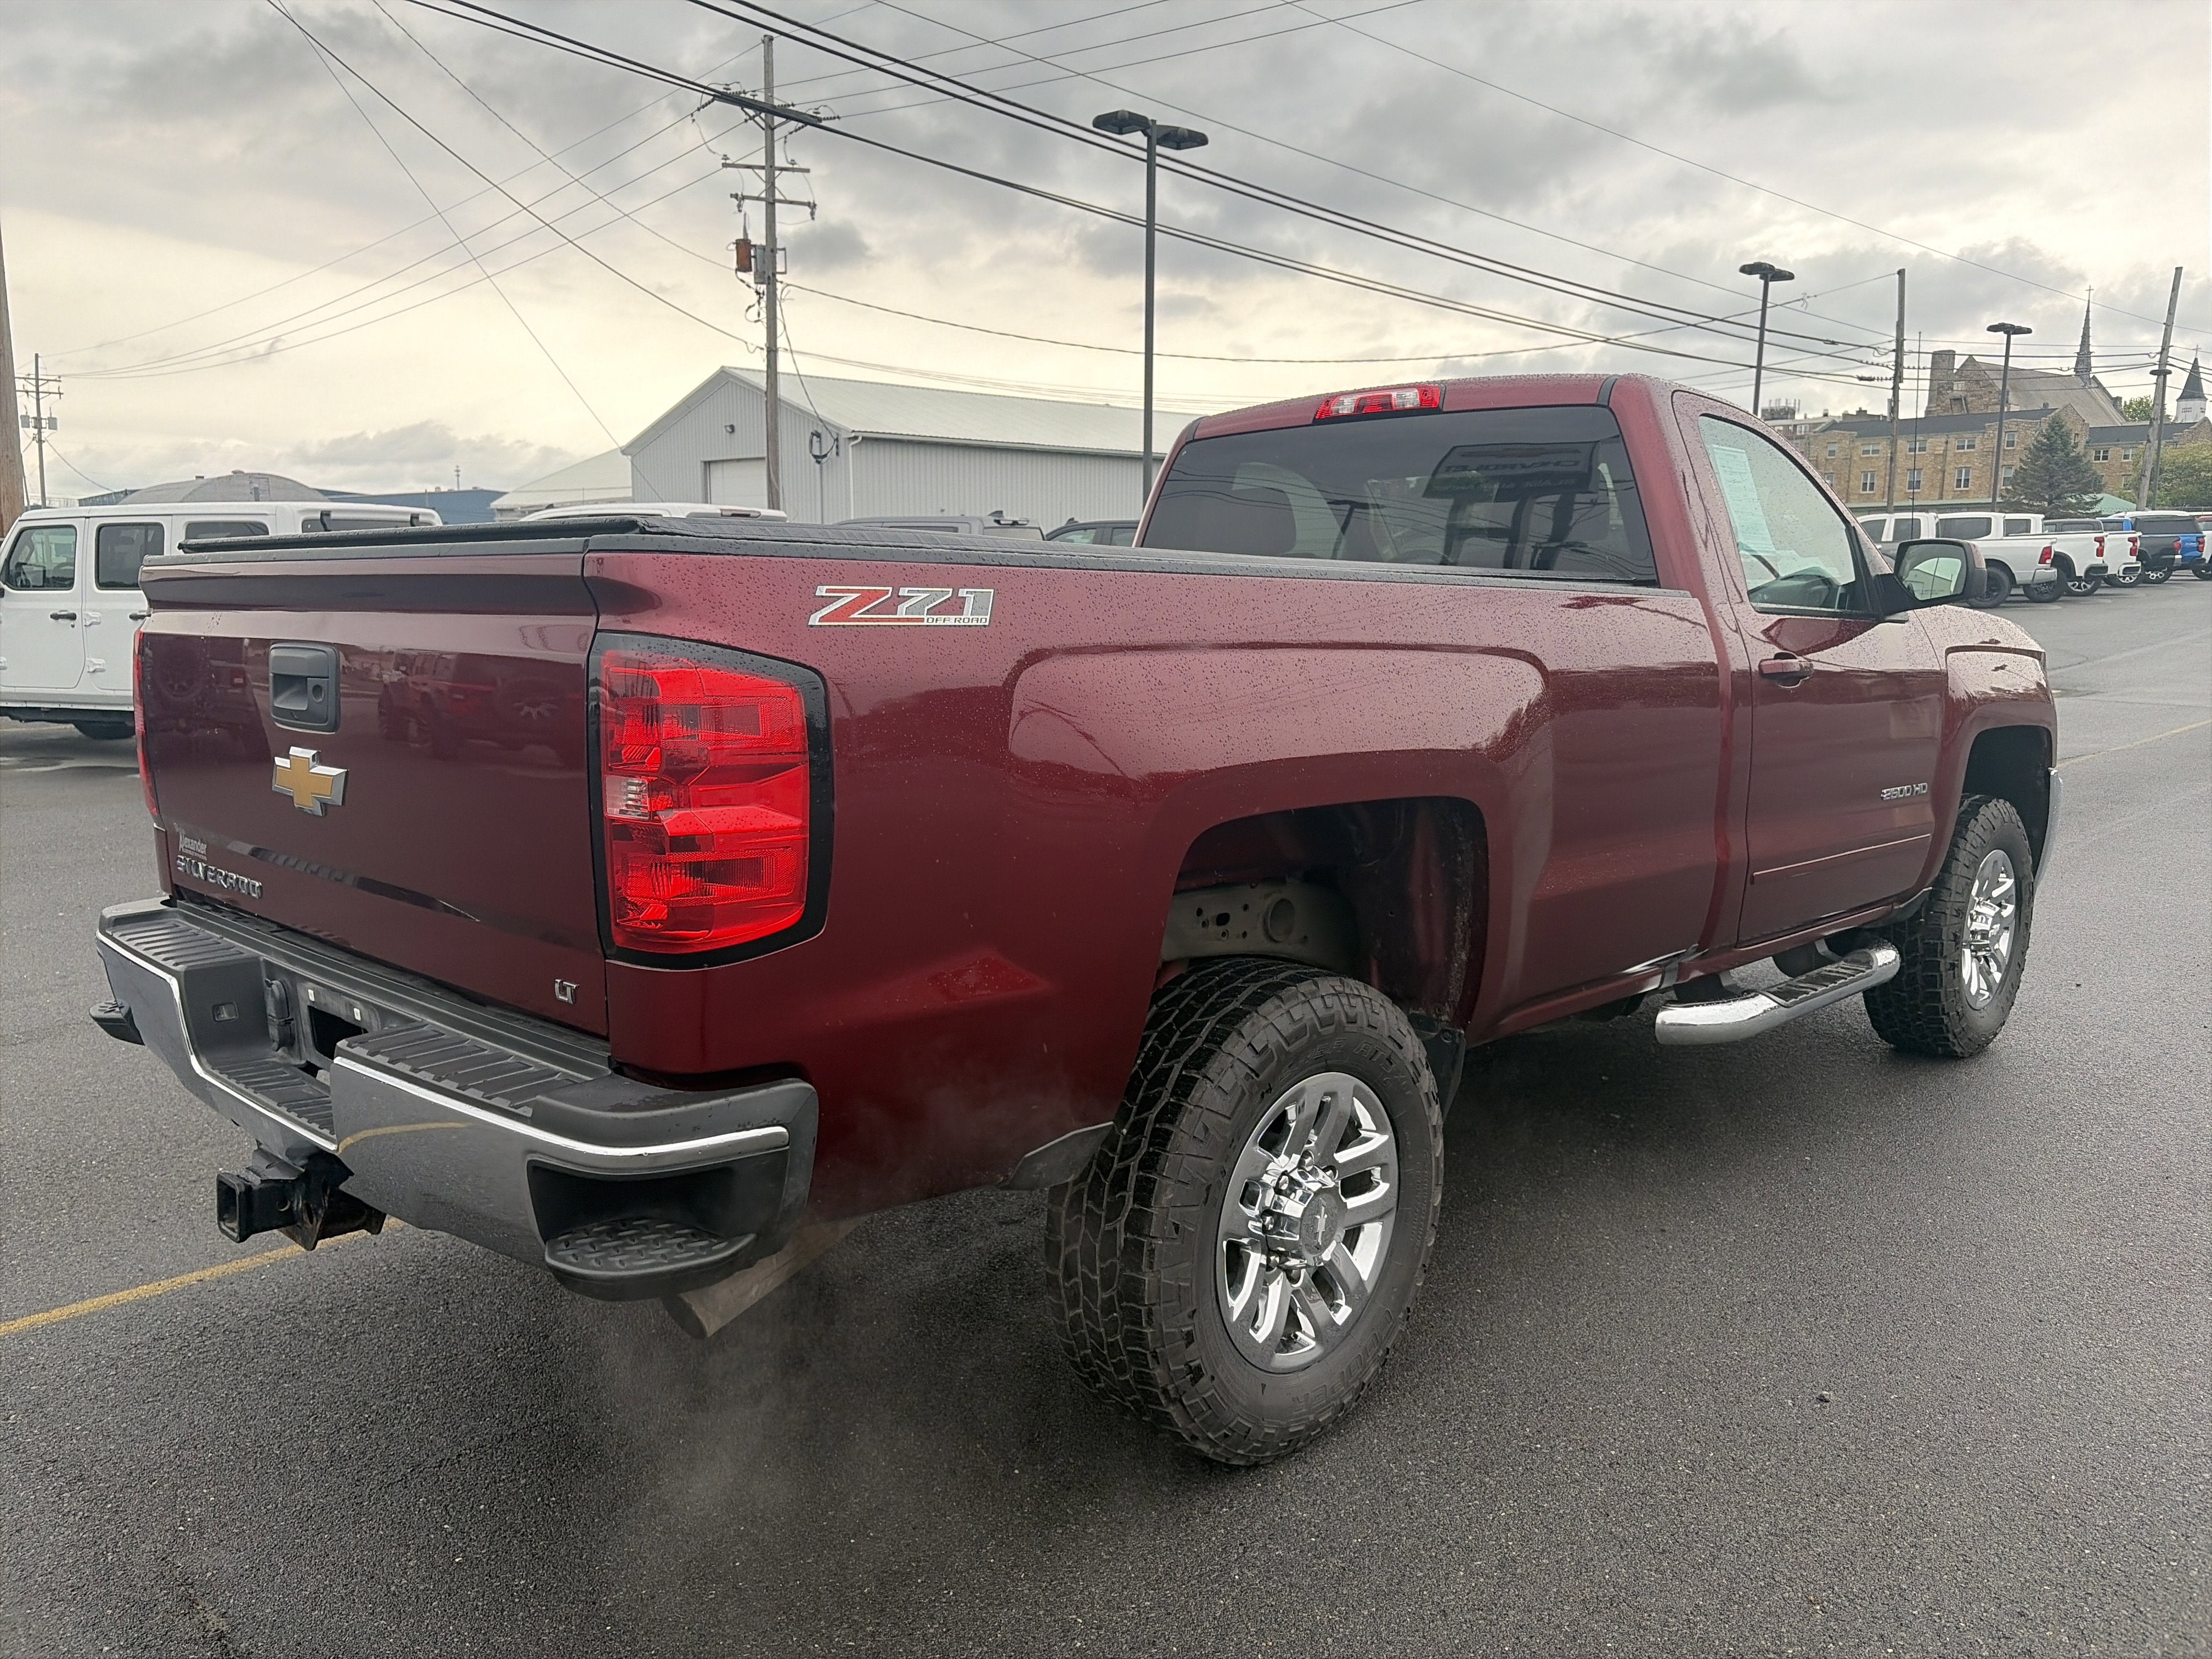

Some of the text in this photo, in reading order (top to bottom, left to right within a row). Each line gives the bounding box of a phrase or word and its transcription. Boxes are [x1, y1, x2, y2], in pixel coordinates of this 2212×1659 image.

[808, 585, 995, 627] Z71
[1912, 782, 1928, 795] HD
[178, 833, 207, 855] Alexander
[177, 855, 263, 899] SILVERADO
[554, 978, 579, 1005] LT
